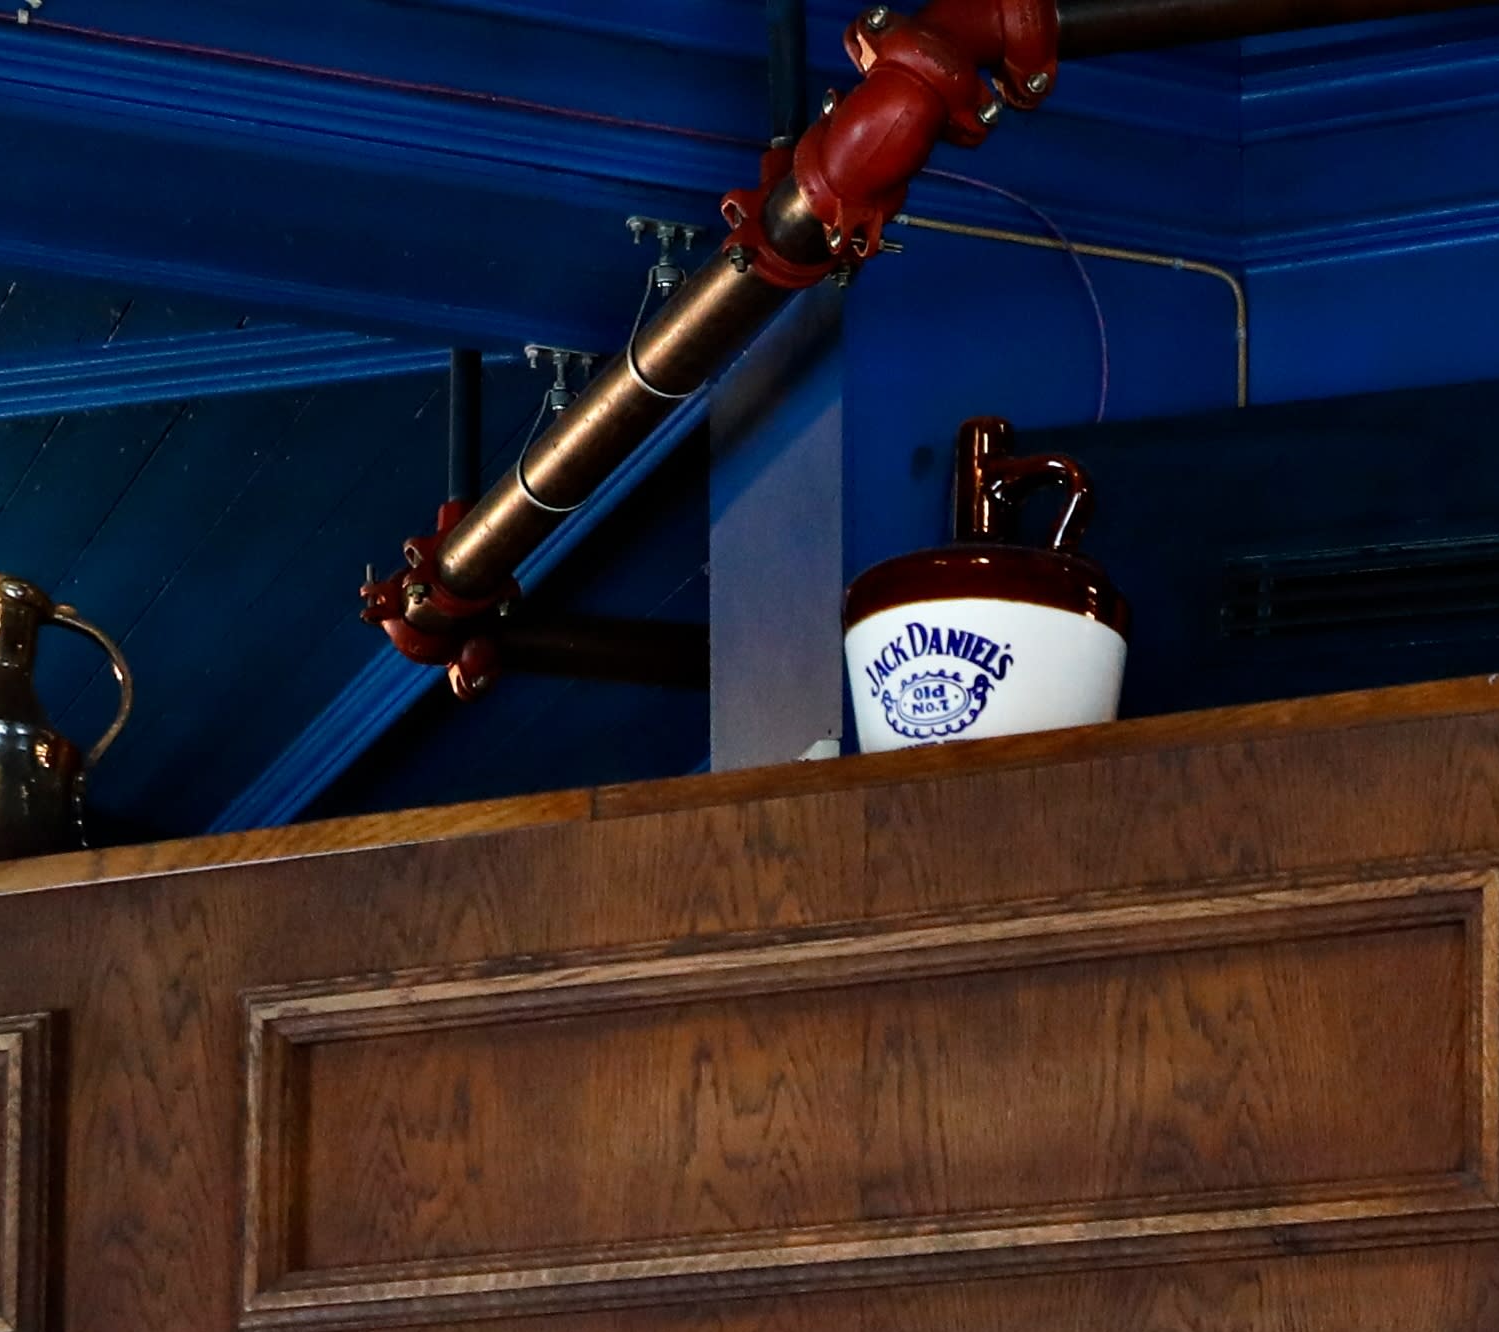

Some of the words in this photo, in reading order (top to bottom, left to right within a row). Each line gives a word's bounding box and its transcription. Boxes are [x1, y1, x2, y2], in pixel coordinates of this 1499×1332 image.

[866, 637, 910, 697] JACK
[906, 623, 1014, 680] DANIEL'S
[913, 684, 945, 700] Old
